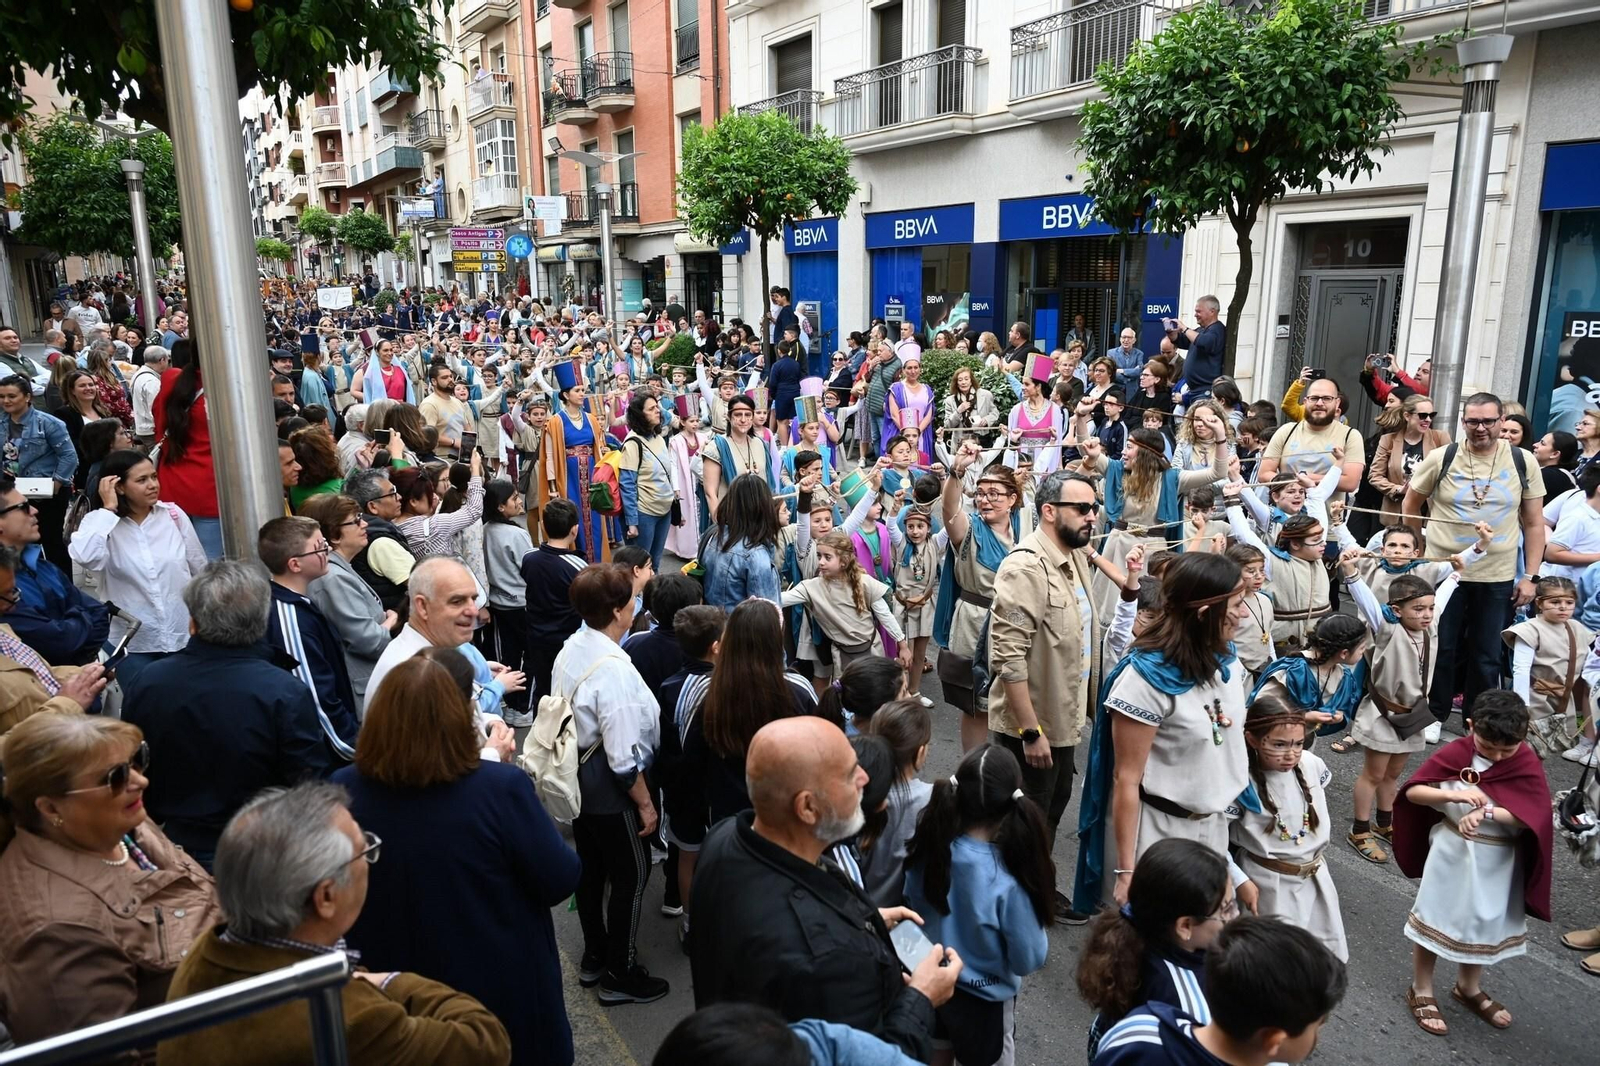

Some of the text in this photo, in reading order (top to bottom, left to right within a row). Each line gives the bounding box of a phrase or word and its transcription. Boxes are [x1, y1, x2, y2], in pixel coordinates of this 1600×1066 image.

[895, 215, 938, 239] BBVA
[794, 225, 828, 246] BBVA
[1344, 239, 1371, 257] 10
[926, 295, 944, 303] BBVA
[972, 302, 989, 311] BBVA
[1147, 304, 1171, 314] BBVA
